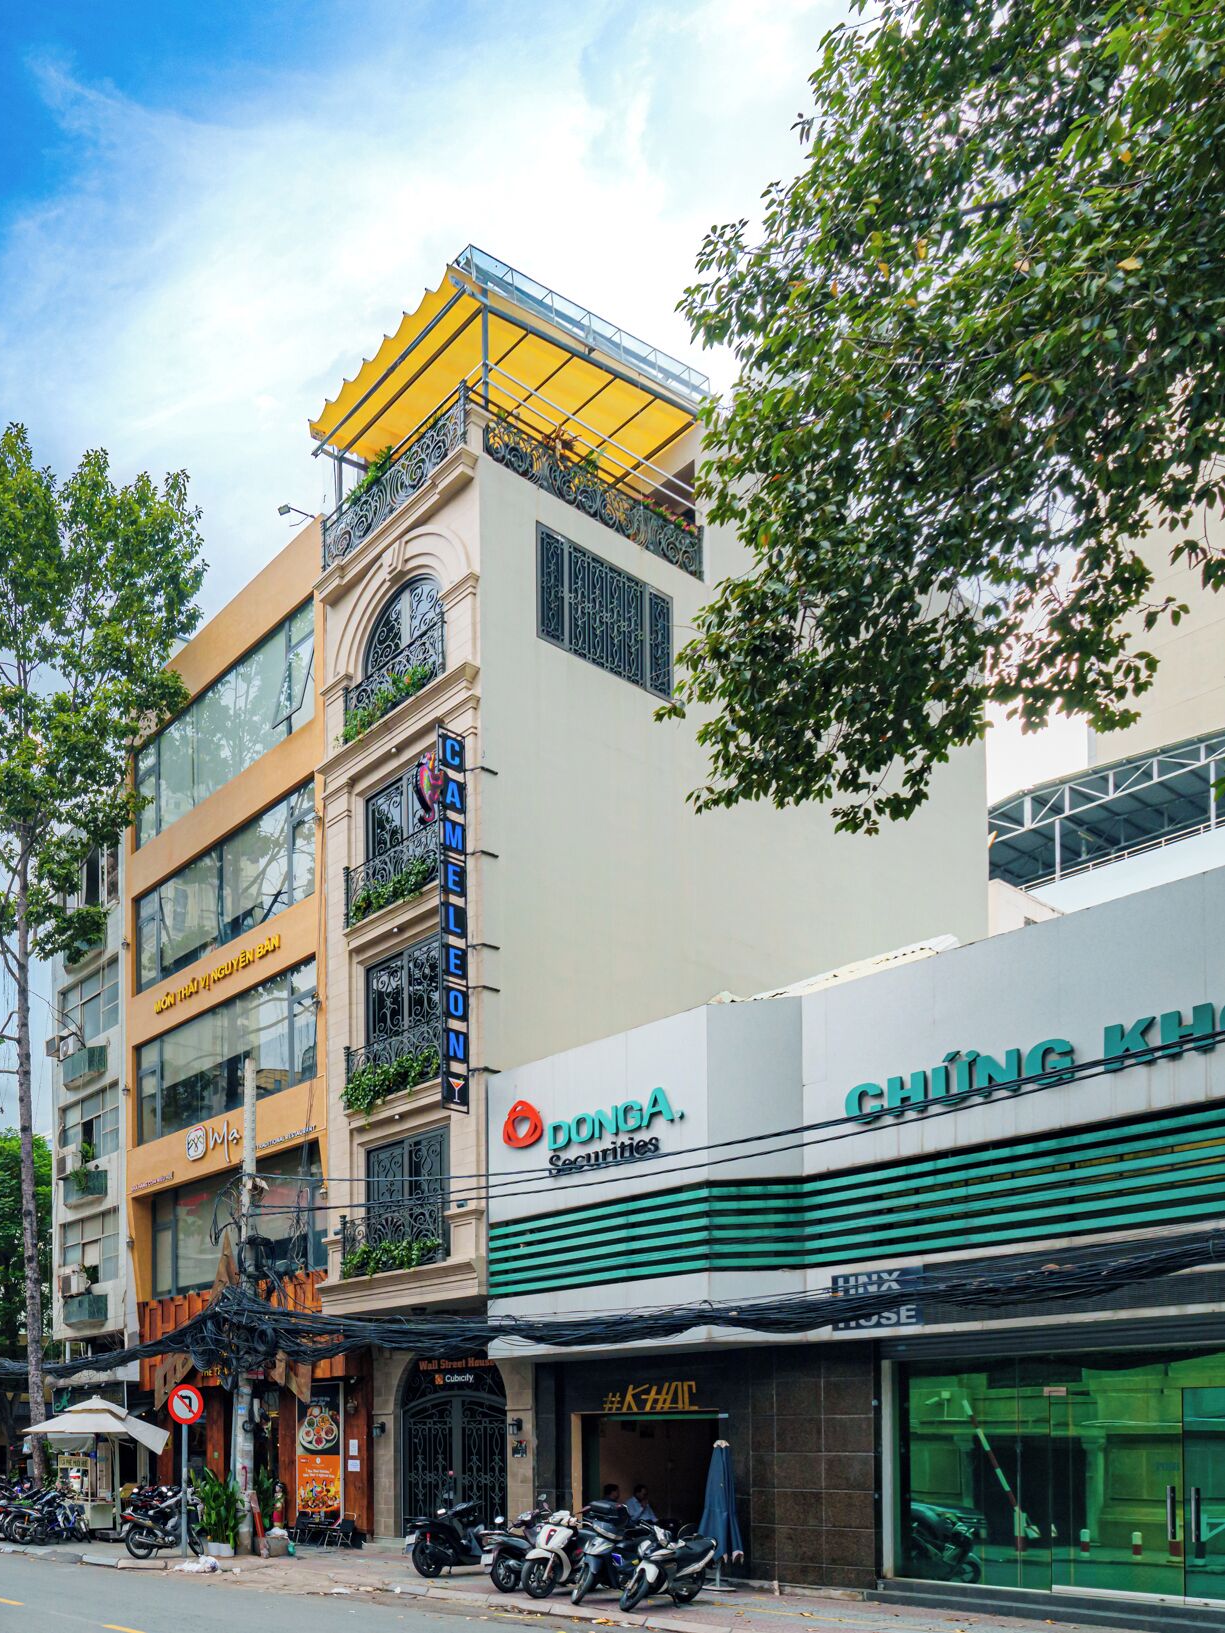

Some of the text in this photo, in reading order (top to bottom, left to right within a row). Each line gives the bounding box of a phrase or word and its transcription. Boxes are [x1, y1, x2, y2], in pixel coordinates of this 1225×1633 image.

[444, 737, 466, 1062] CAMELEON
[177, 977, 199, 1001] THÁI
[200, 973, 211, 992] VỊ
[211, 948, 255, 984] NGUYÊN
[844, 1002, 1225, 1124] CHỨNG KH
[547, 1086, 674, 1151] DONGA
[548, 1137, 660, 1177] Securities
[837, 1270, 902, 1296] HNX
[419, 1357, 495, 1371] Wall Street House
[445, 1374, 474, 1383] Cubicity
